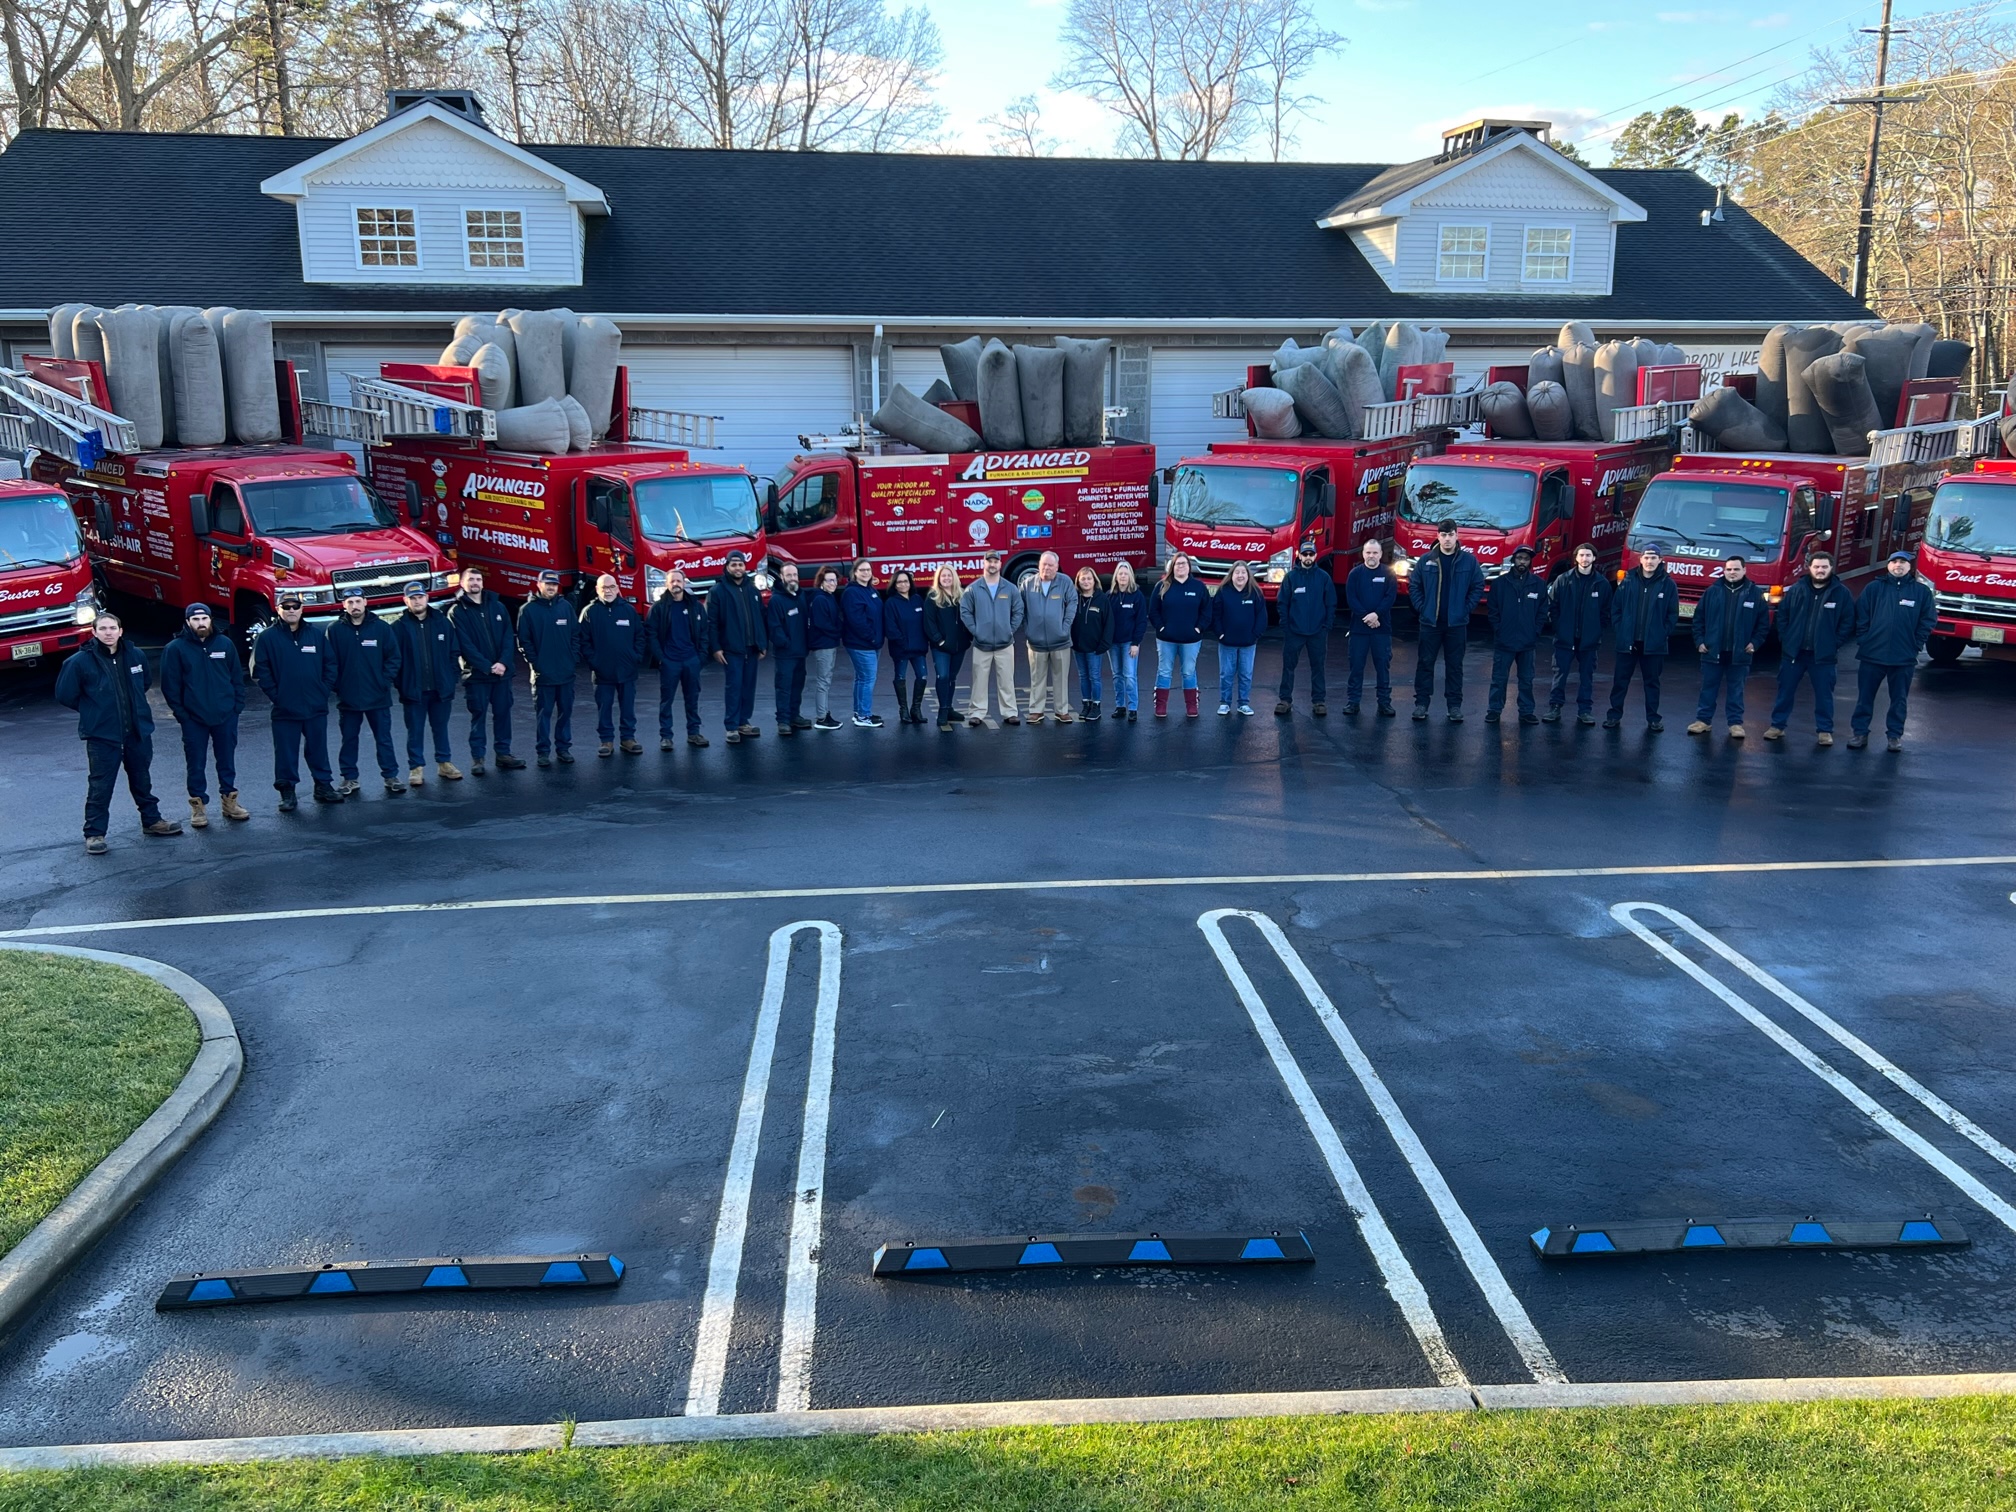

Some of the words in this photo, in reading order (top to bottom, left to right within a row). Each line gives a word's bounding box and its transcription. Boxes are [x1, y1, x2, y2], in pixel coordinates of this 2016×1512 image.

[1686, 352, 1724, 369] BODY
[1731, 350, 1760, 367] LIKE
[962, 452, 1090, 480] ADVANCED
[463, 472, 545, 499] ADVANCED
[1597, 464, 1651, 497] ADVANCED
[871, 490, 895, 498] QUALITY
[897, 489, 936, 497] SPECIALISTS
[1078, 494, 1108, 502] CHIMNEYS
[1091, 486, 1111, 494] DUCTS
[1099, 525, 1149, 533] ENCAPSULATING
[462, 525, 549, 554] 877-4-FRESH-AIR
[1183, 537, 1208, 548] Dust
[1209, 539, 1242, 550] Buster
[1245, 542, 1265, 552] 130
[1412, 539, 1431, 549] Du
[1460, 546, 1474, 554] ter
[1477, 545, 1498, 555] 100
[1675, 545, 1720, 557] ISUZU
[373, 558, 396, 566] Buster
[674, 559, 700, 570] Dust
[702, 556, 727, 567] Bust
[1667, 561, 1704, 577] BUSTER
[1945, 570, 1982, 583] Dust
[1985, 574, 2016, 587] Bust
[0, 589, 40, 602] Buster
[44, 583, 63, 595] 65
